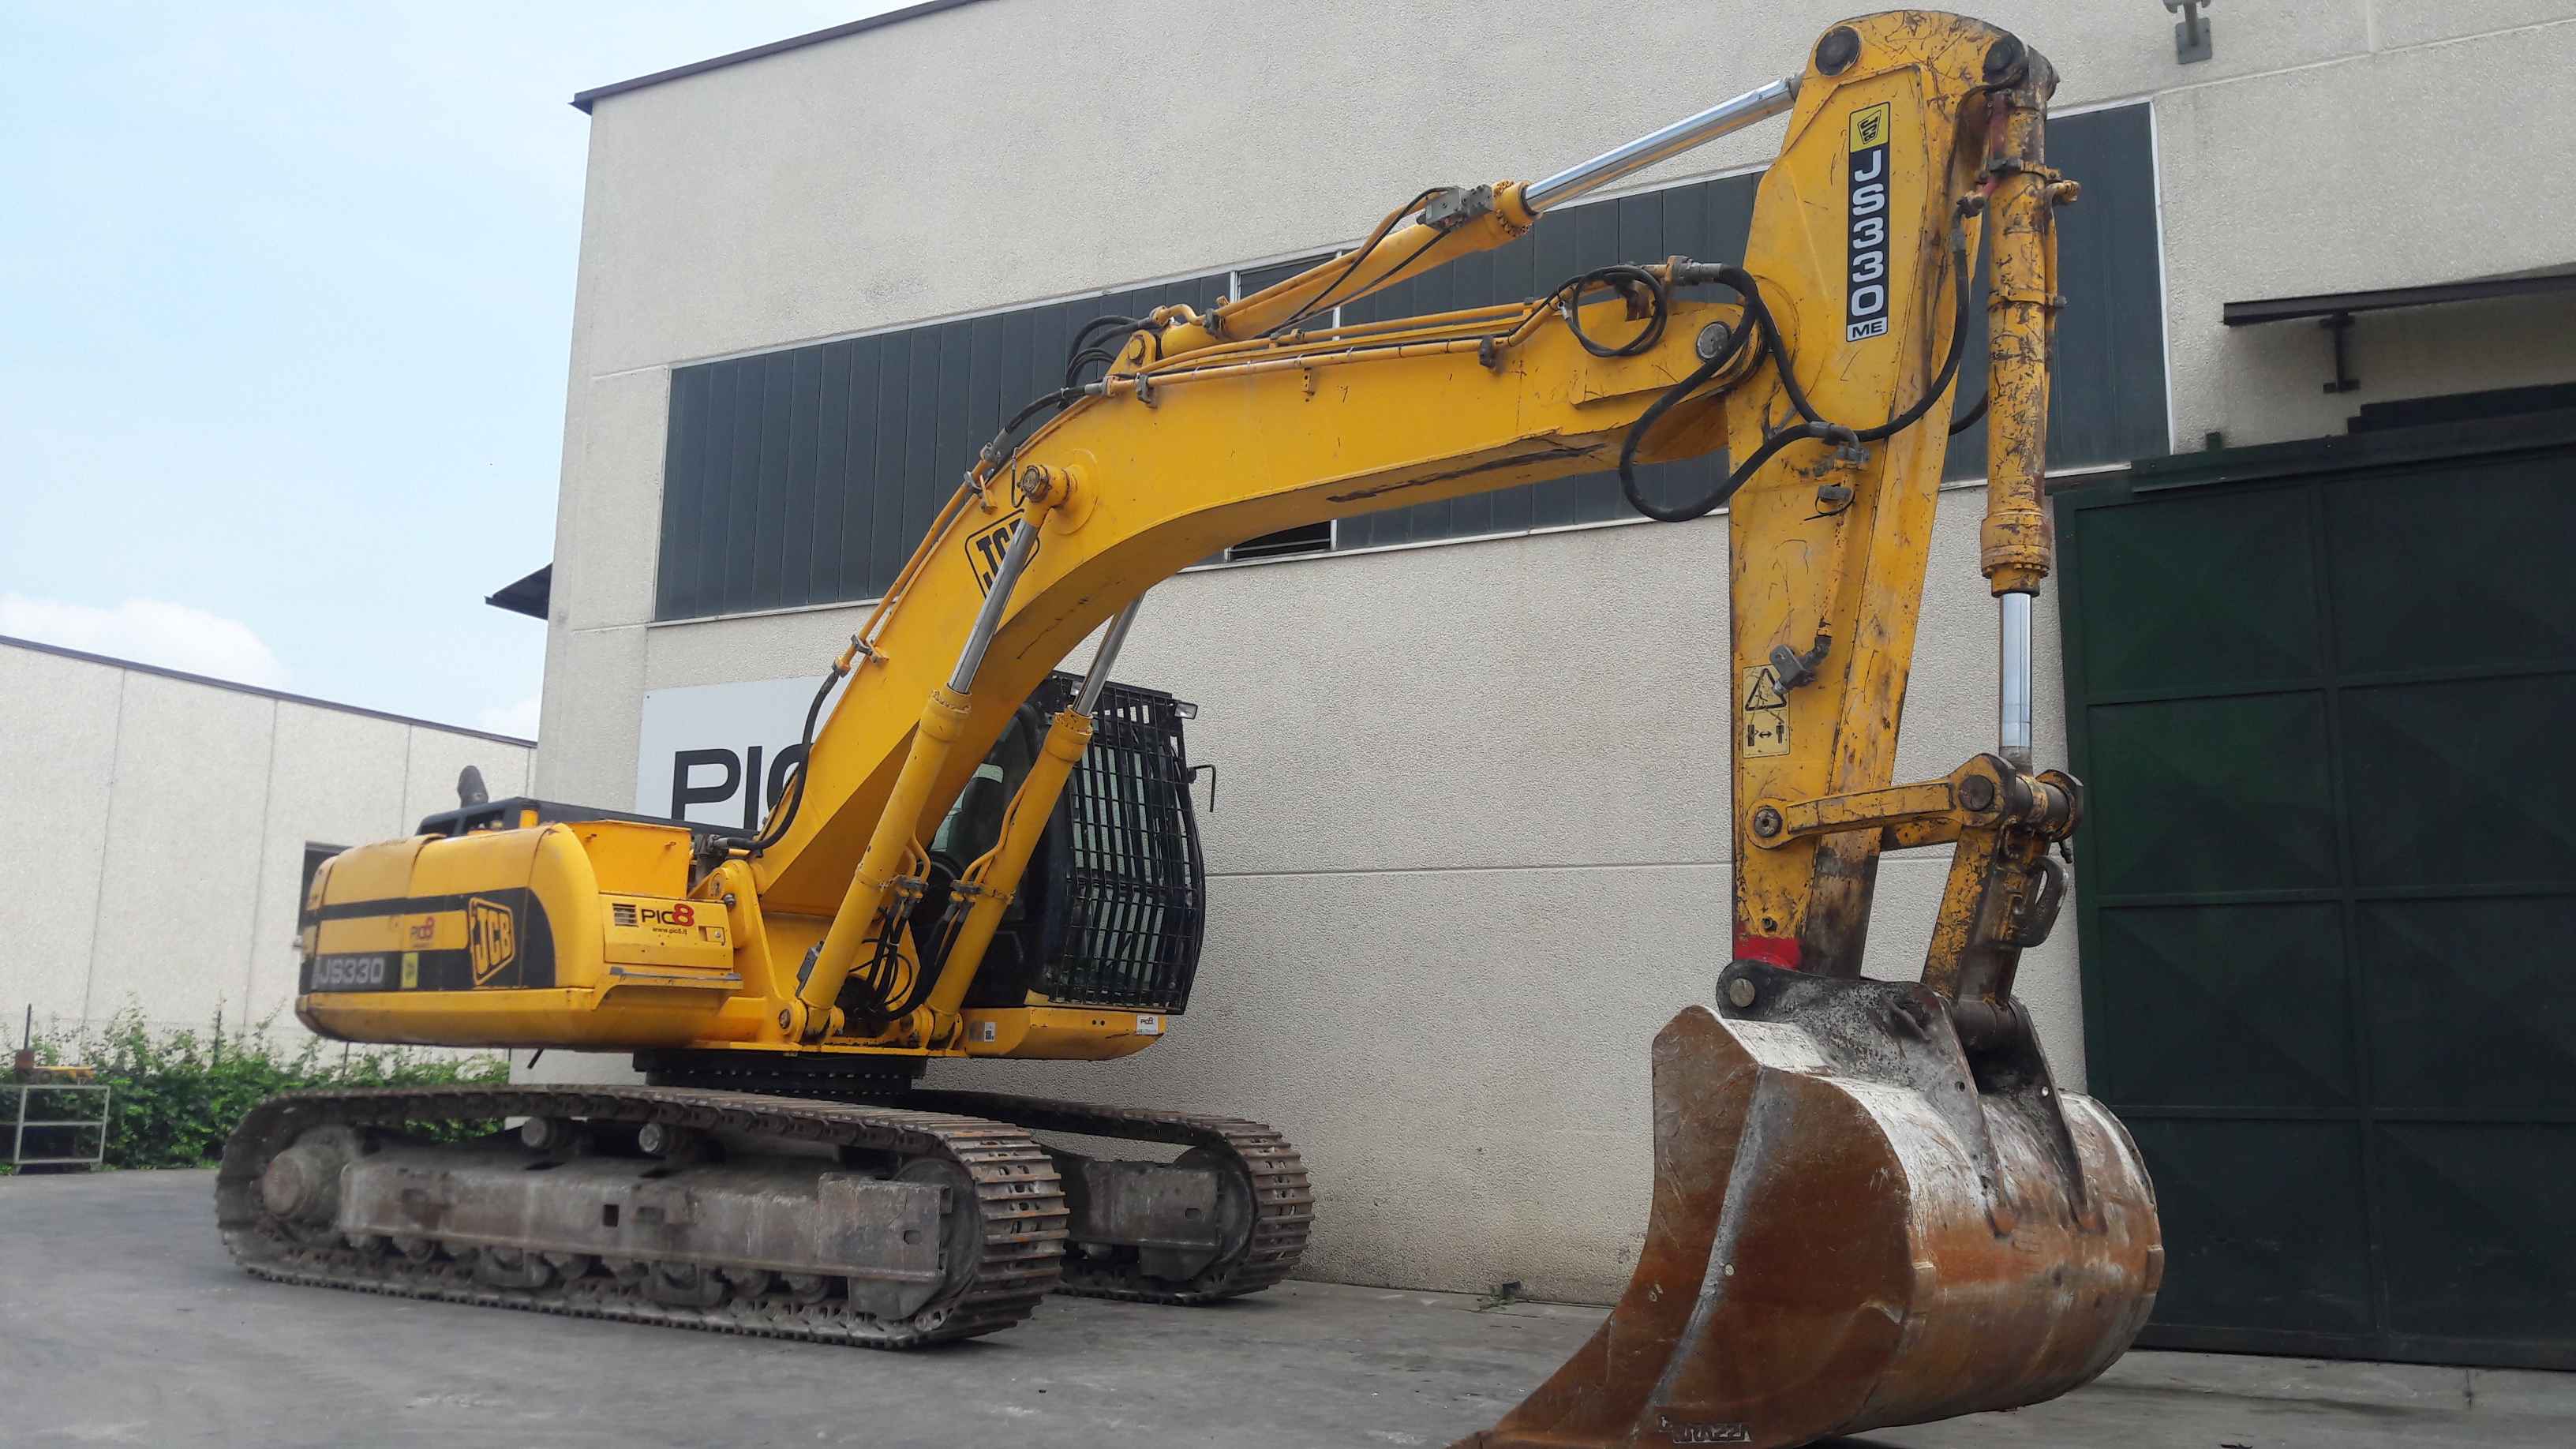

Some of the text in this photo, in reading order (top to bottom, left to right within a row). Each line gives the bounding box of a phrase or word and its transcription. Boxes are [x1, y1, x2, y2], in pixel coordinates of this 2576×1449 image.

[1859, 115, 1878, 142] JCB
[1851, 149, 1885, 316] JS330
[1852, 320, 1884, 339] ME
[976, 518, 1022, 592] JC
[641, 903, 695, 927] PIC8
[474, 907, 512, 975] JCB
[315, 957, 385, 984] JS330
